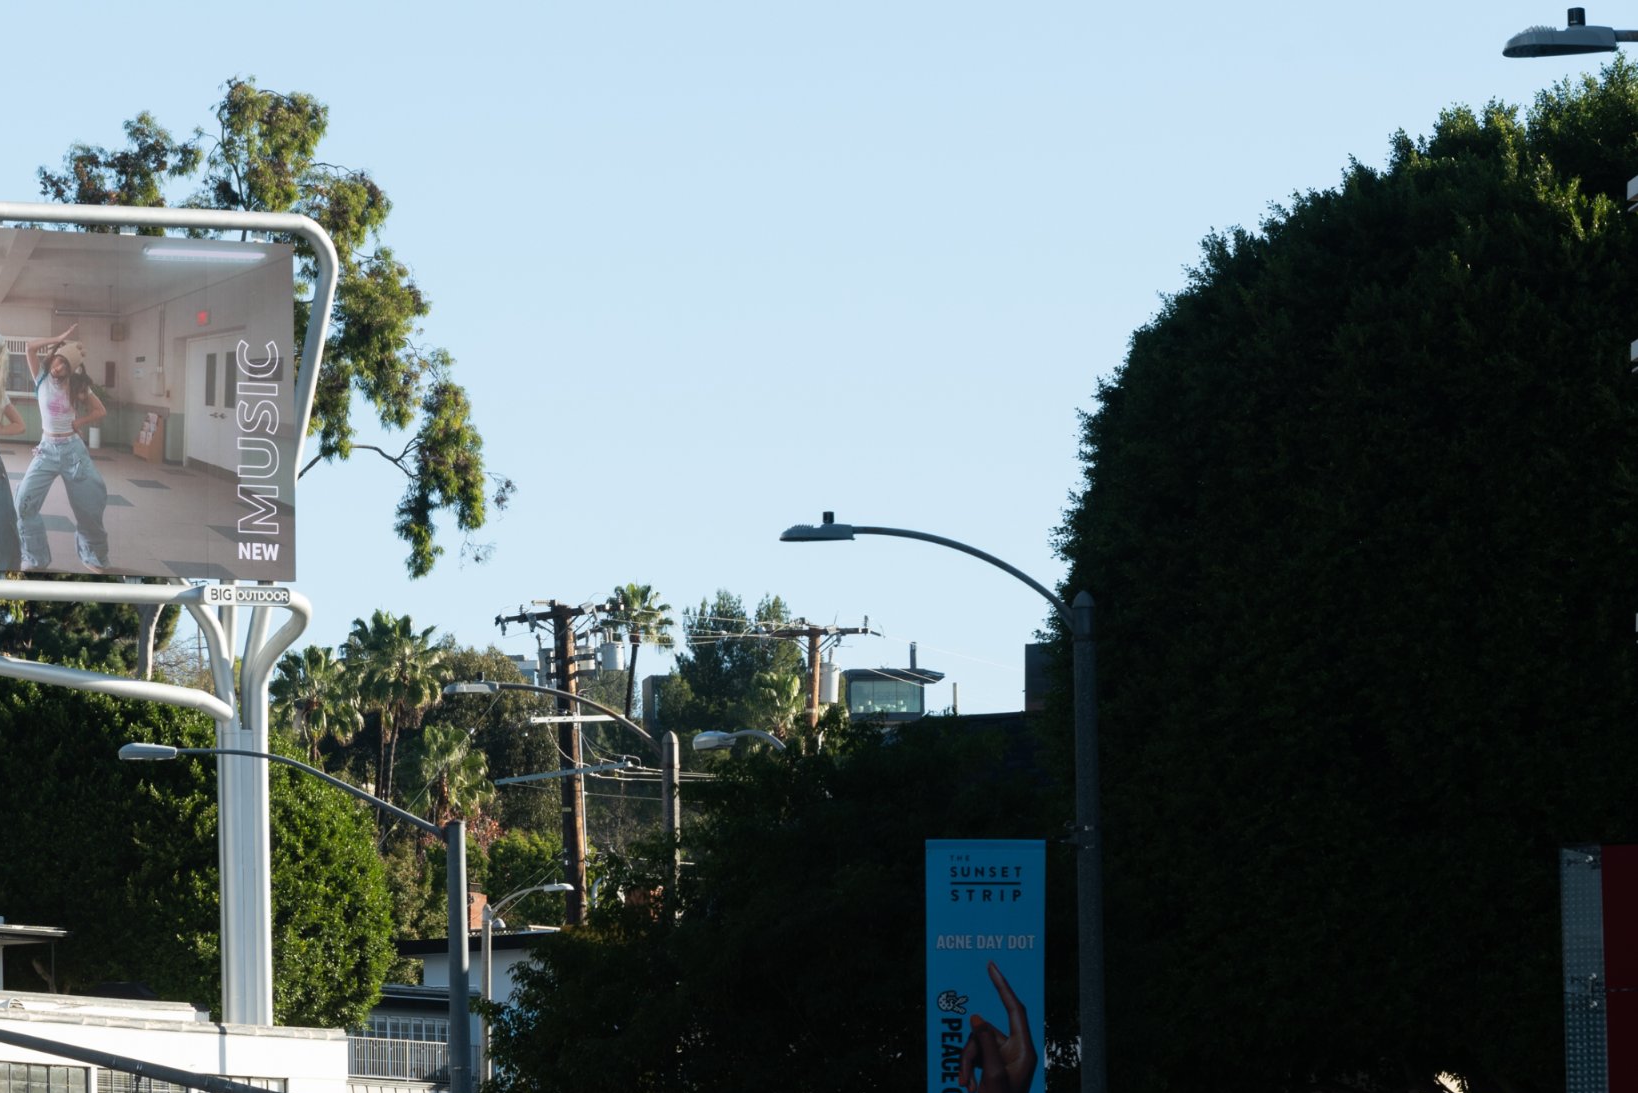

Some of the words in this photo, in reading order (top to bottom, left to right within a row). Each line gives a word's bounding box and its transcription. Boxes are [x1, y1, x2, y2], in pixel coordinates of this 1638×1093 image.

[236, 339, 280, 535] MUSIC
[238, 542, 280, 561] NEW
[210, 588, 232, 601] BIG
[236, 590, 289, 602] OUTDOOR
[949, 854, 970, 862] THE
[949, 866, 1022, 878] SUNSET
[950, 889, 1022, 902] STRIP
[936, 934, 973, 950] ACNE
[976, 934, 1004, 950] DAY
[1008, 934, 1036, 950] DOT
[941, 1017, 963, 1083] PEACE
